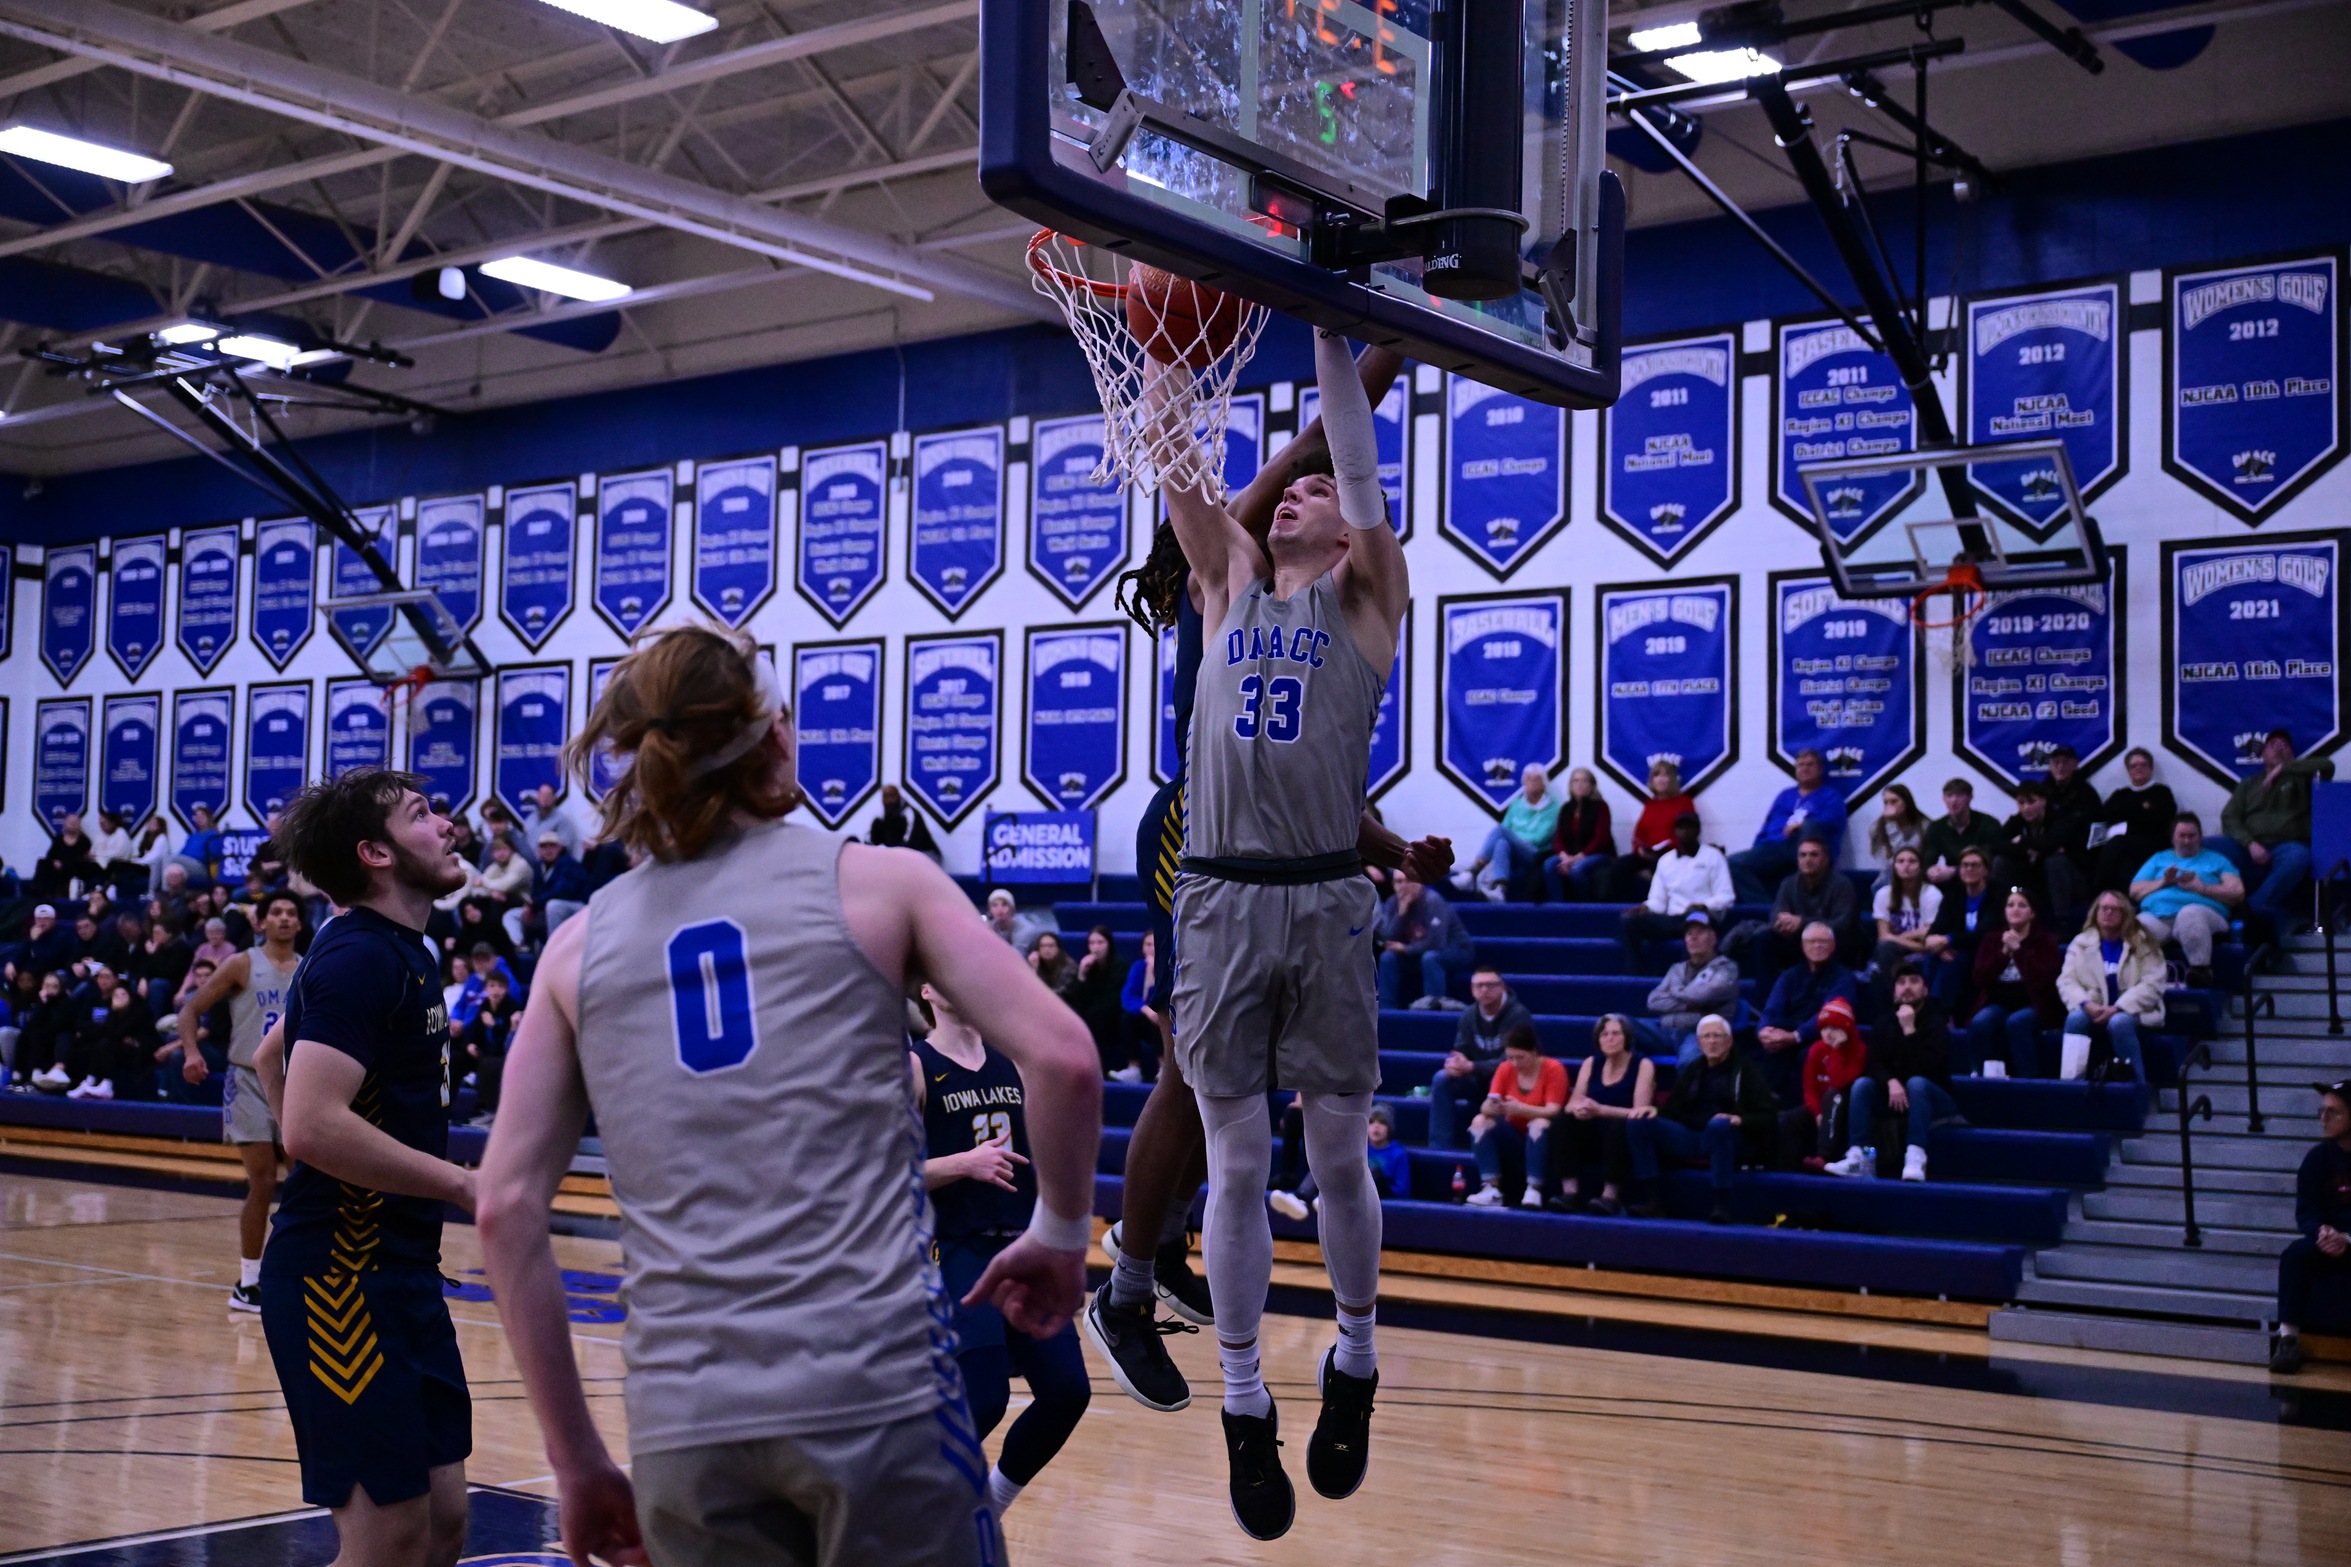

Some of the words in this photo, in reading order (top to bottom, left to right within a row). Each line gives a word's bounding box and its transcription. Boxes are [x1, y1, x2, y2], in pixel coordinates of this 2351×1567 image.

[2182, 274, 2275, 331] WOMEN'S
[2278, 273, 2327, 314] GOLF
[2229, 318, 2279, 341] 2012
[2018, 343, 2065, 366] 2012
[1827, 366, 1868, 387] 2011
[1650, 387, 1689, 408] 2011
[2180, 384, 2238, 407] NJCAA
[2284, 377, 2330, 397] Place
[2014, 393, 2068, 415] NJCAA
[1990, 412, 2051, 436] National
[2182, 553, 2276, 607] WOMEN'S
[2278, 553, 2329, 598] GOLF
[1670, 595, 1719, 632] GOLF
[2229, 599, 2280, 620] 2021
[1824, 619, 1867, 639] 2019
[1988, 613, 2089, 635] 2019-2020
[2034, 645, 2092, 666] Champs
[2181, 662, 2238, 683] NJCAA
[2285, 658, 2331, 678] Place
[1971, 677, 2022, 697] Region
[2050, 672, 2107, 693] Champs
[1233, 672, 1304, 744] 33
[1977, 702, 2032, 722] NJCAA
[993, 823, 1084, 846] GENERAL
[664, 915, 760, 1078] 0
[942, 1089, 982, 1113] IOWA
[981, 1086, 1022, 1105] LAKES
